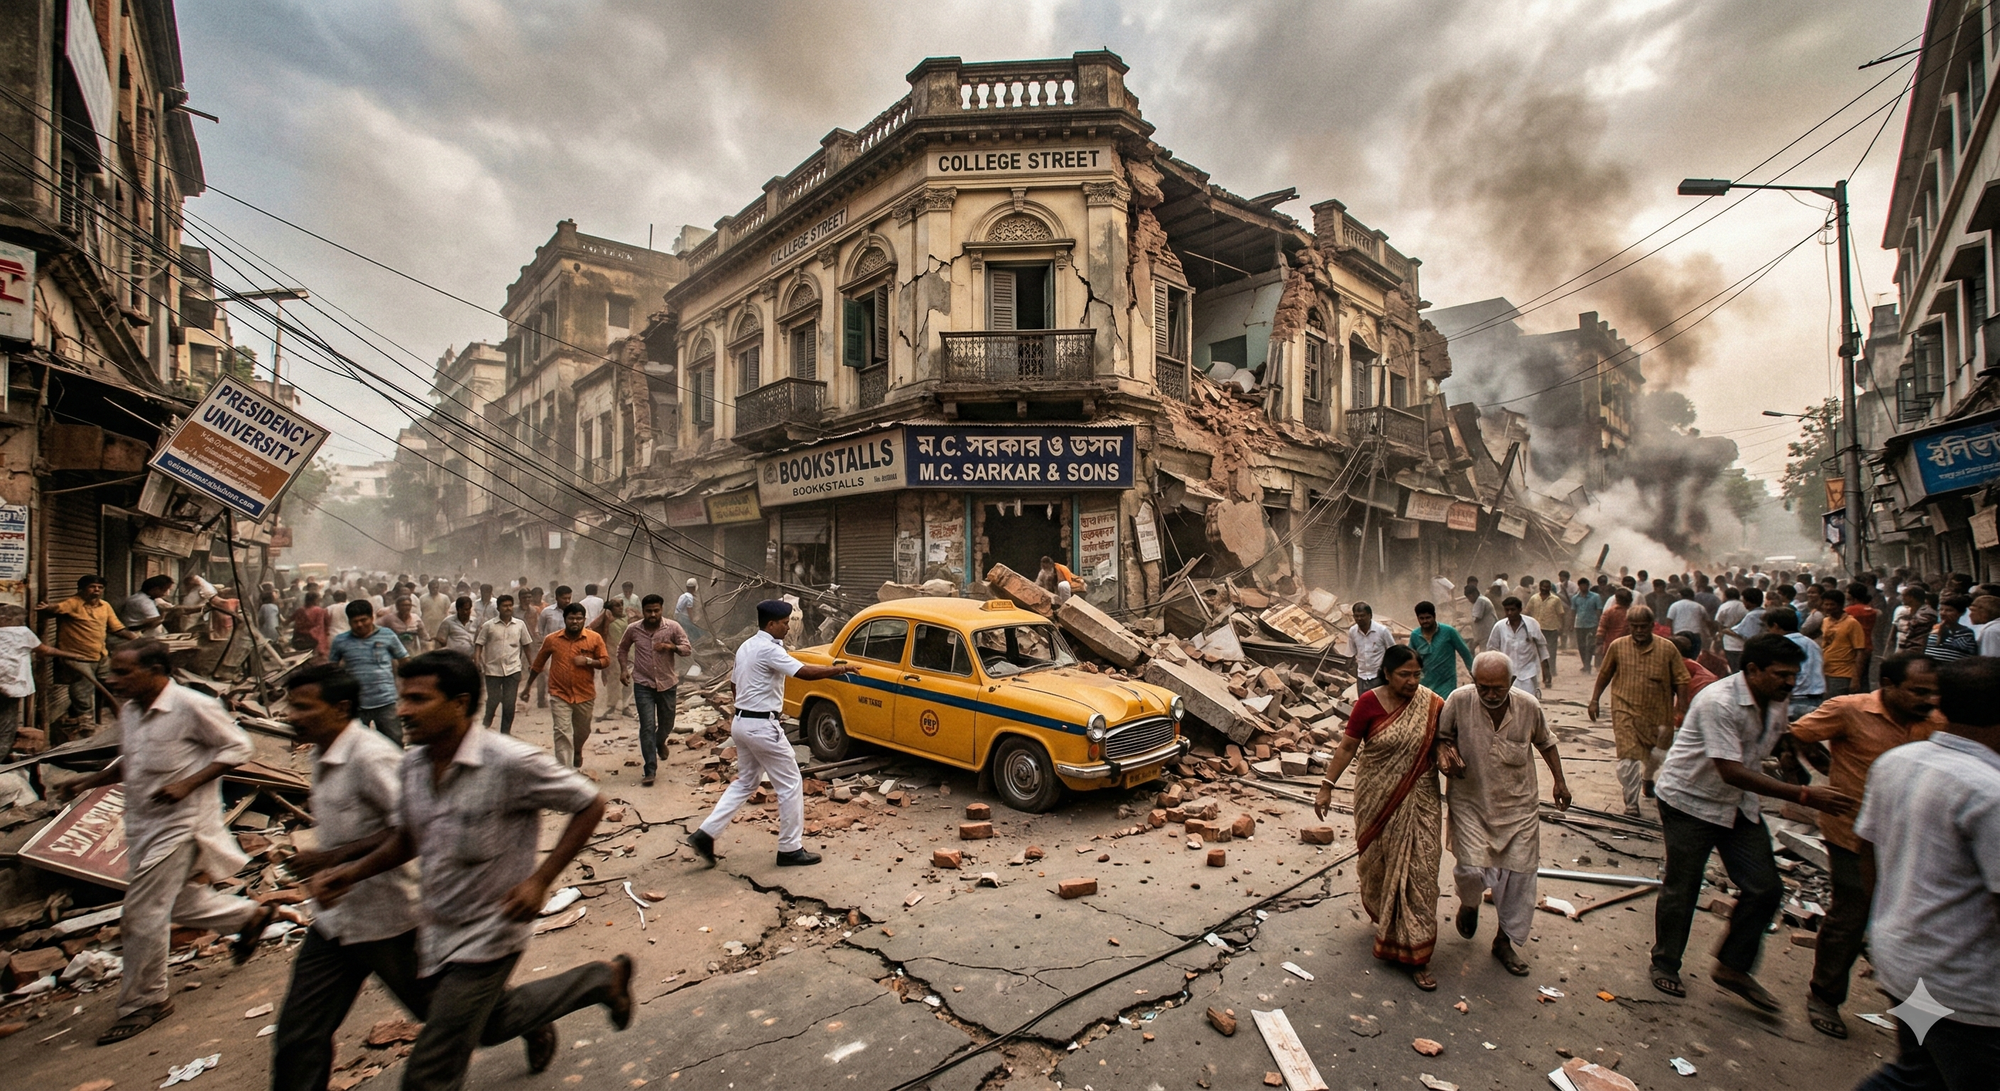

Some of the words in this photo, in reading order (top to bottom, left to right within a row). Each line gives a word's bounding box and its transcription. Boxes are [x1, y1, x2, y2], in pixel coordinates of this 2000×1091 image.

[938, 153, 1021, 172] COLLEGE
[1028, 150, 1100, 169] STREET
[810, 209, 845, 242] STREET
[215, 384, 315, 447] PRESIDENCY
[203, 404, 301, 466] UNIVERSITY
[965, 436, 1043, 457] সরকার
[1047, 436, 1064, 457] ও
[779, 439, 894, 485] BOOKSTALLS
[919, 463, 958, 481] M.C.
[962, 463, 1041, 481] SARKAR
[1046, 463, 1061, 481] &
[1067, 463, 1119, 481] SONS
[792, 477, 864, 497] BOOKKSTALLS
